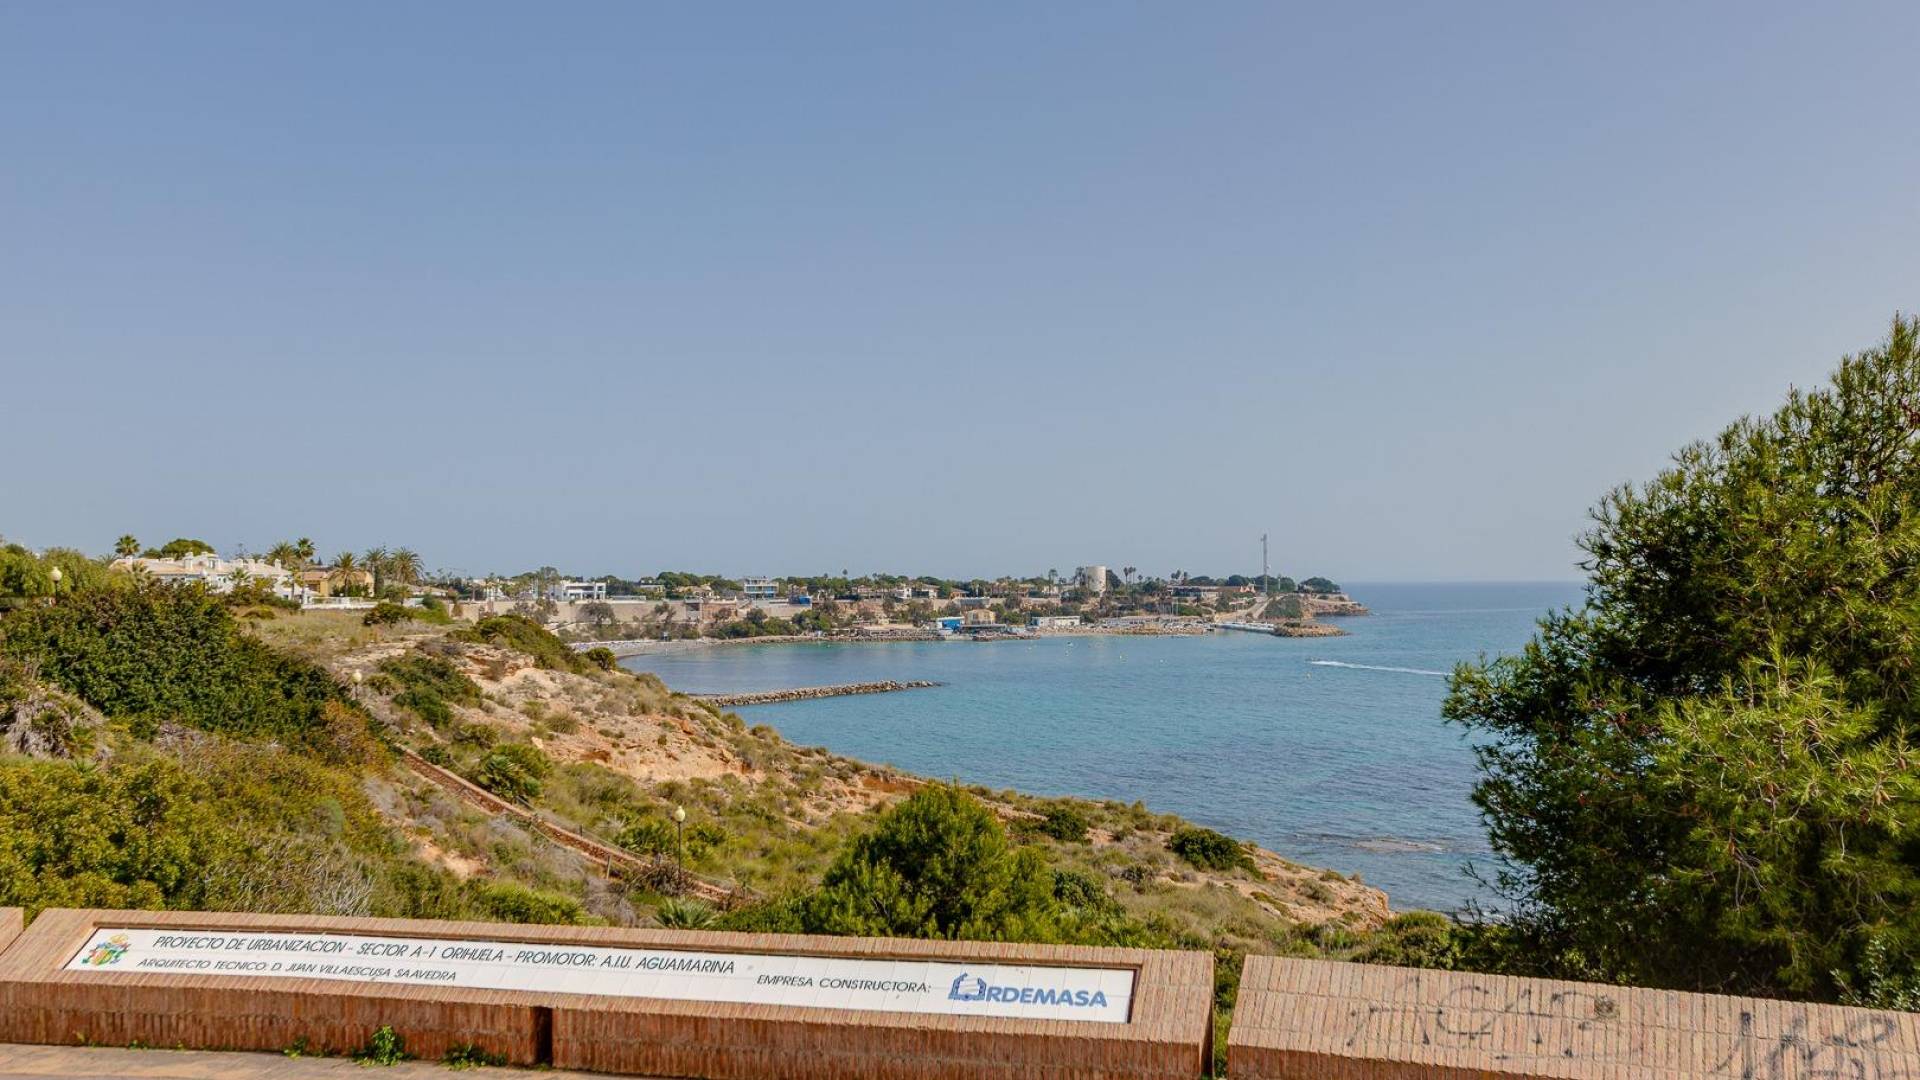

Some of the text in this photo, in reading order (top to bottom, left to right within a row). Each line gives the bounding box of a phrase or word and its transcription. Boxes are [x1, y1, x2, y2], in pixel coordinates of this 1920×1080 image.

[152, 936, 225, 950] PROYECTO
[225, 938, 245, 950] DE
[246, 938, 348, 953] URBANIZACION
[356, 942, 409, 957] SECTOR
[441, 946, 504, 962] ORIHUELA
[514, 950, 598, 967] PROMOTOR:
[636, 956, 735, 974] AGUAMARINA
[136, 957, 211, 970] ARQUITECTO
[285, 962, 317, 974] JUAN
[319, 964, 391, 977] VILLAESCUSA
[394, 968, 457, 981] SAAVEDRA
[757, 974, 932, 993] EMPRESA CONSTRUCTORA:
